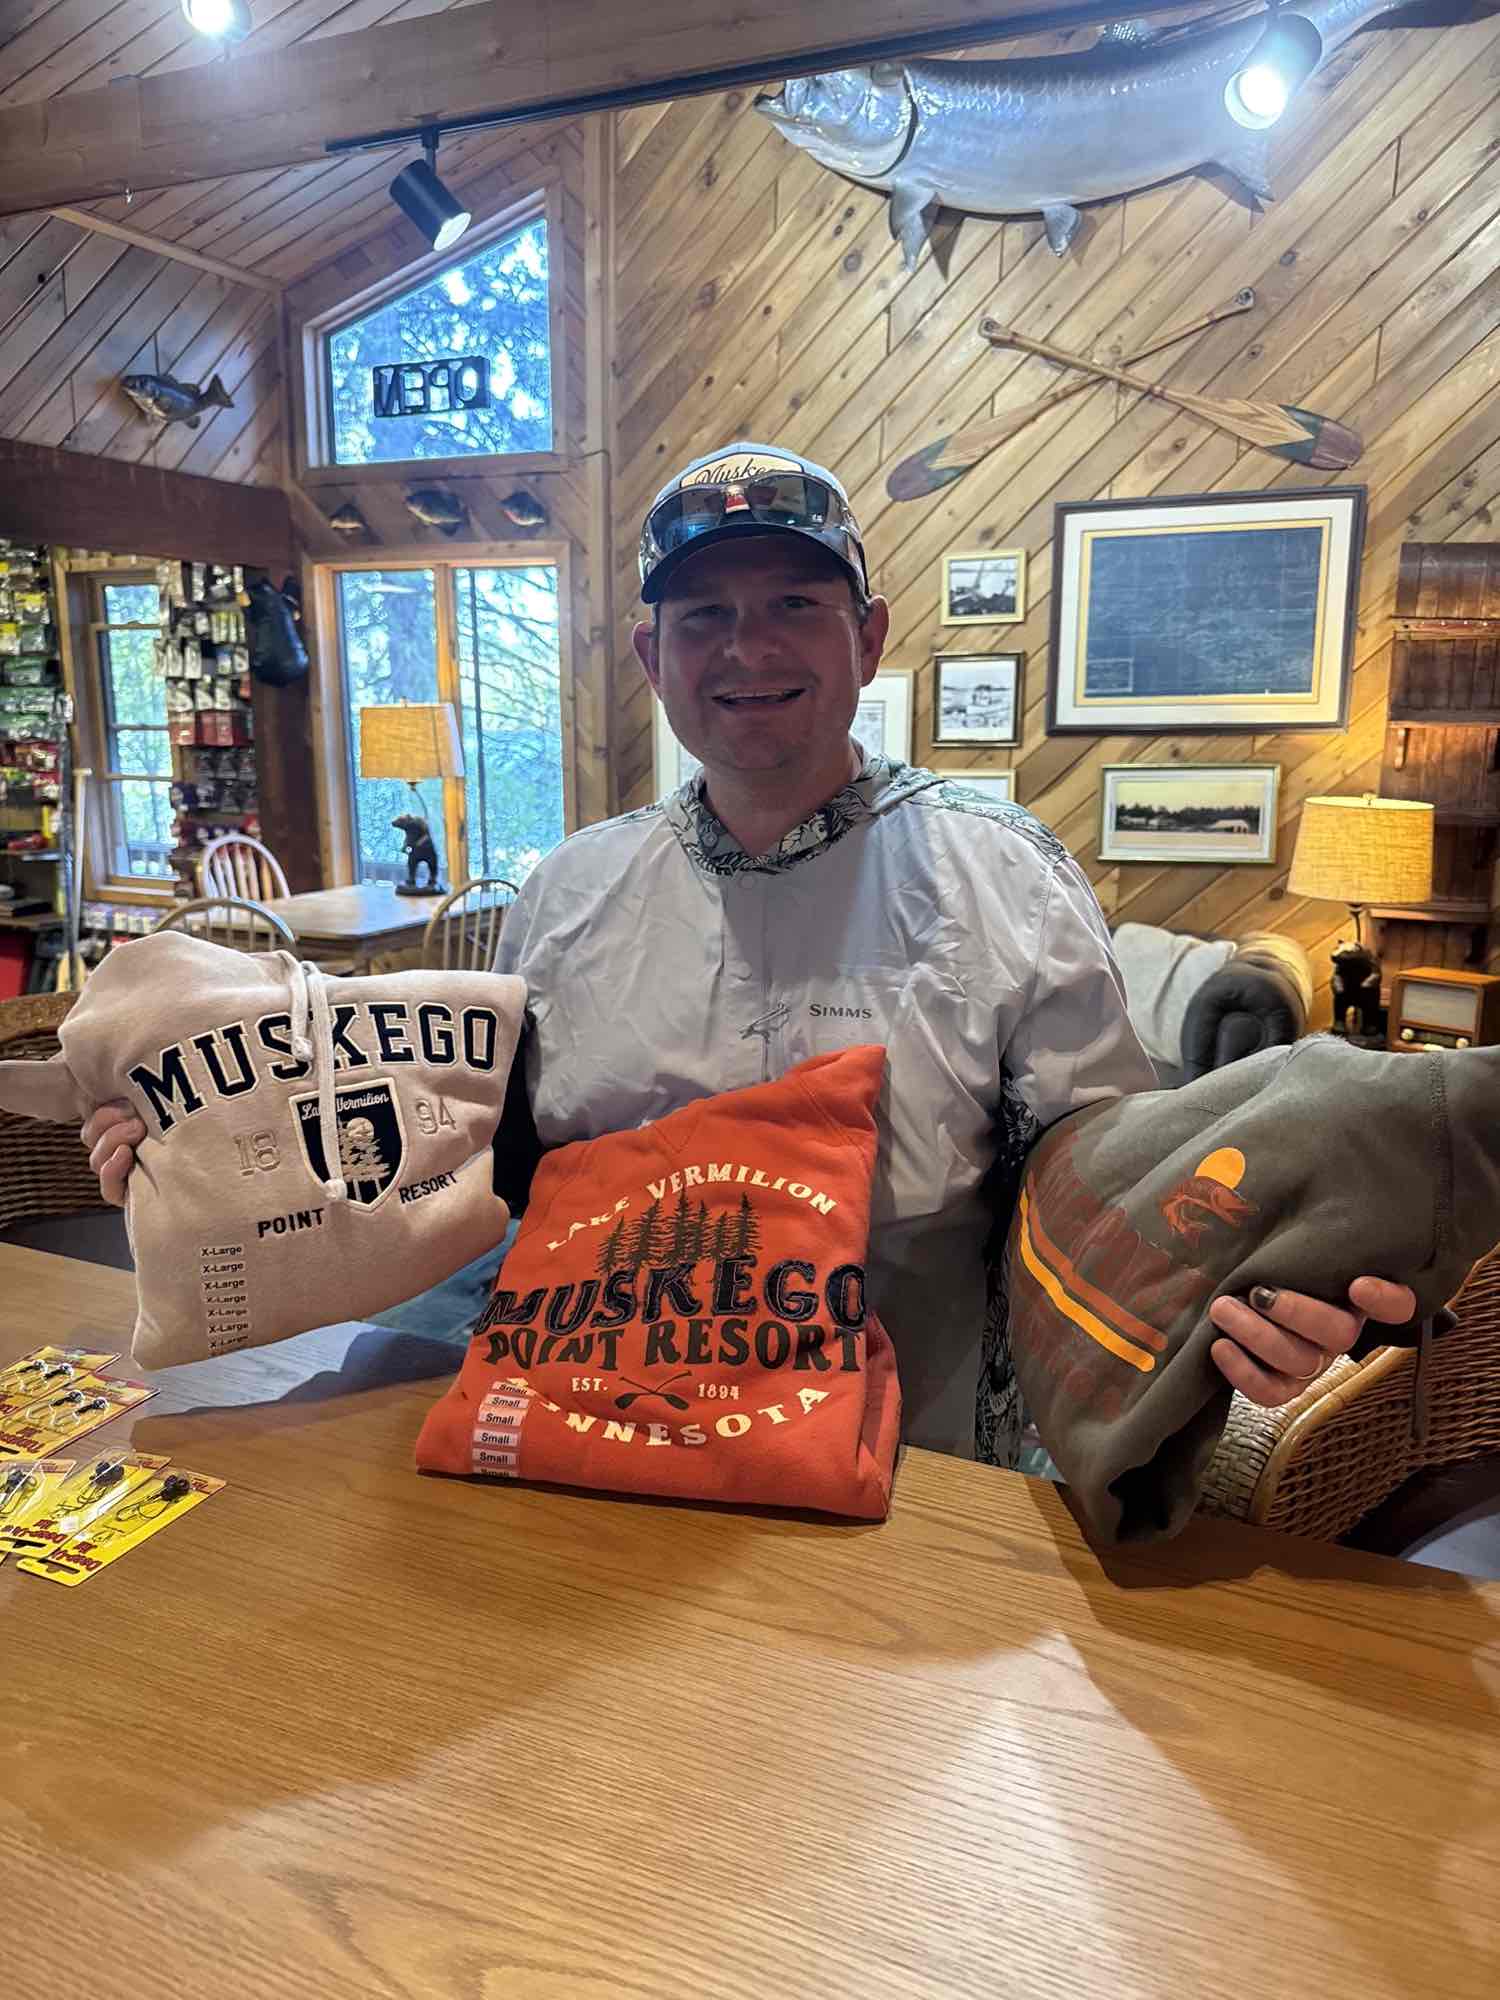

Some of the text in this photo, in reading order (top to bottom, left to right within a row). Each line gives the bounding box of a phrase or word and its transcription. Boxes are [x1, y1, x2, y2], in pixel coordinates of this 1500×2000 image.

[809, 1003, 872, 1019] SIMMS
[128, 1000, 497, 1136] MUSKEGO
[336, 1092, 390, 1113] Vermilion
[232, 1095, 458, 1177] 18 94
[257, 1170, 459, 1238] POINT RESORT
[546, 1162, 838, 1251] LAKE VERMILION
[201, 1245, 243, 1256] X-Large
[203, 1262, 244, 1273] X-Large
[204, 1279, 246, 1290] X-Large
[472, 1253, 868, 1337] MUSKEGO
[207, 1308, 248, 1318] X-Large
[209, 1320, 249, 1333] X-Large
[481, 1318, 864, 1372] POINT RESORT
[499, 1383, 528, 1395] Small
[571, 1377, 741, 1400] EST. 1894
[492, 1396, 520, 1408] Small
[485, 1412, 514, 1425] Small
[481, 1432, 510, 1444] Small
[479, 1451, 508, 1464] Small
